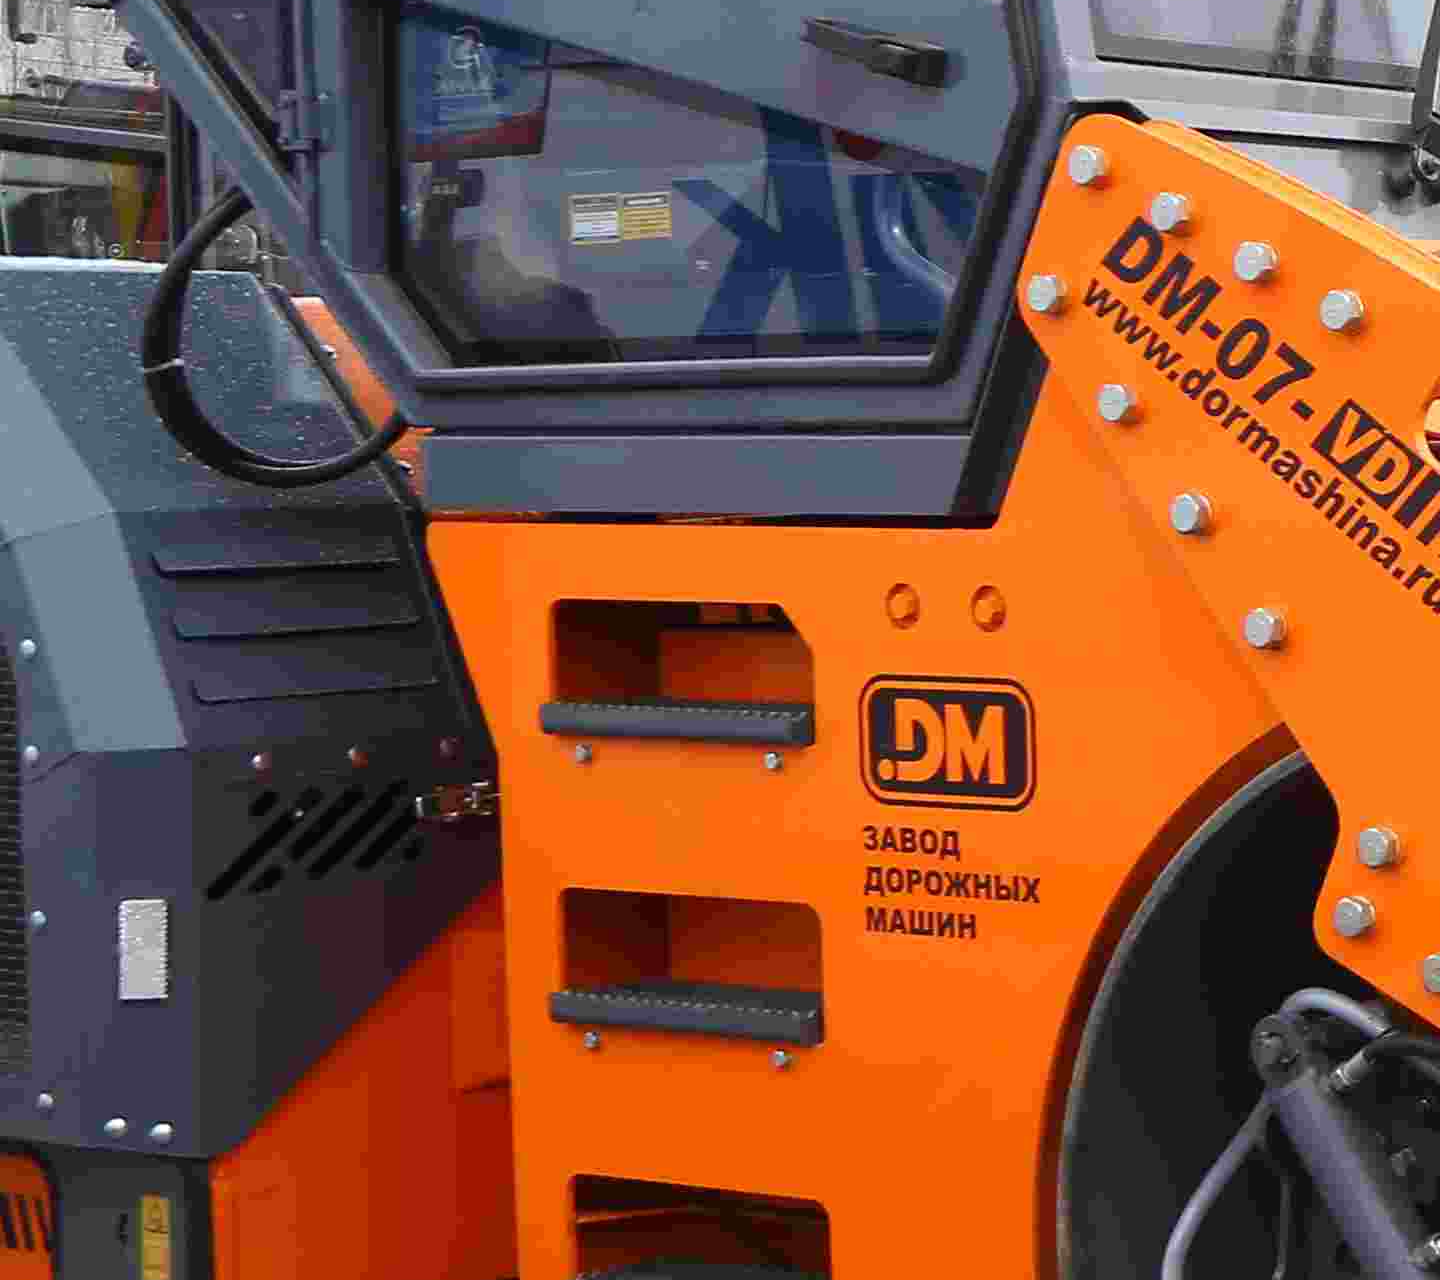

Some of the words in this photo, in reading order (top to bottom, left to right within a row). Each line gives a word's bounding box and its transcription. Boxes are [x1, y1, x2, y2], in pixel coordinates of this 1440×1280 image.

[862, 824, 961, 862] ЗАВОД
[863, 866, 1041, 904] ДОРОЖНЫХ
[865, 906, 977, 940] МАШИН
